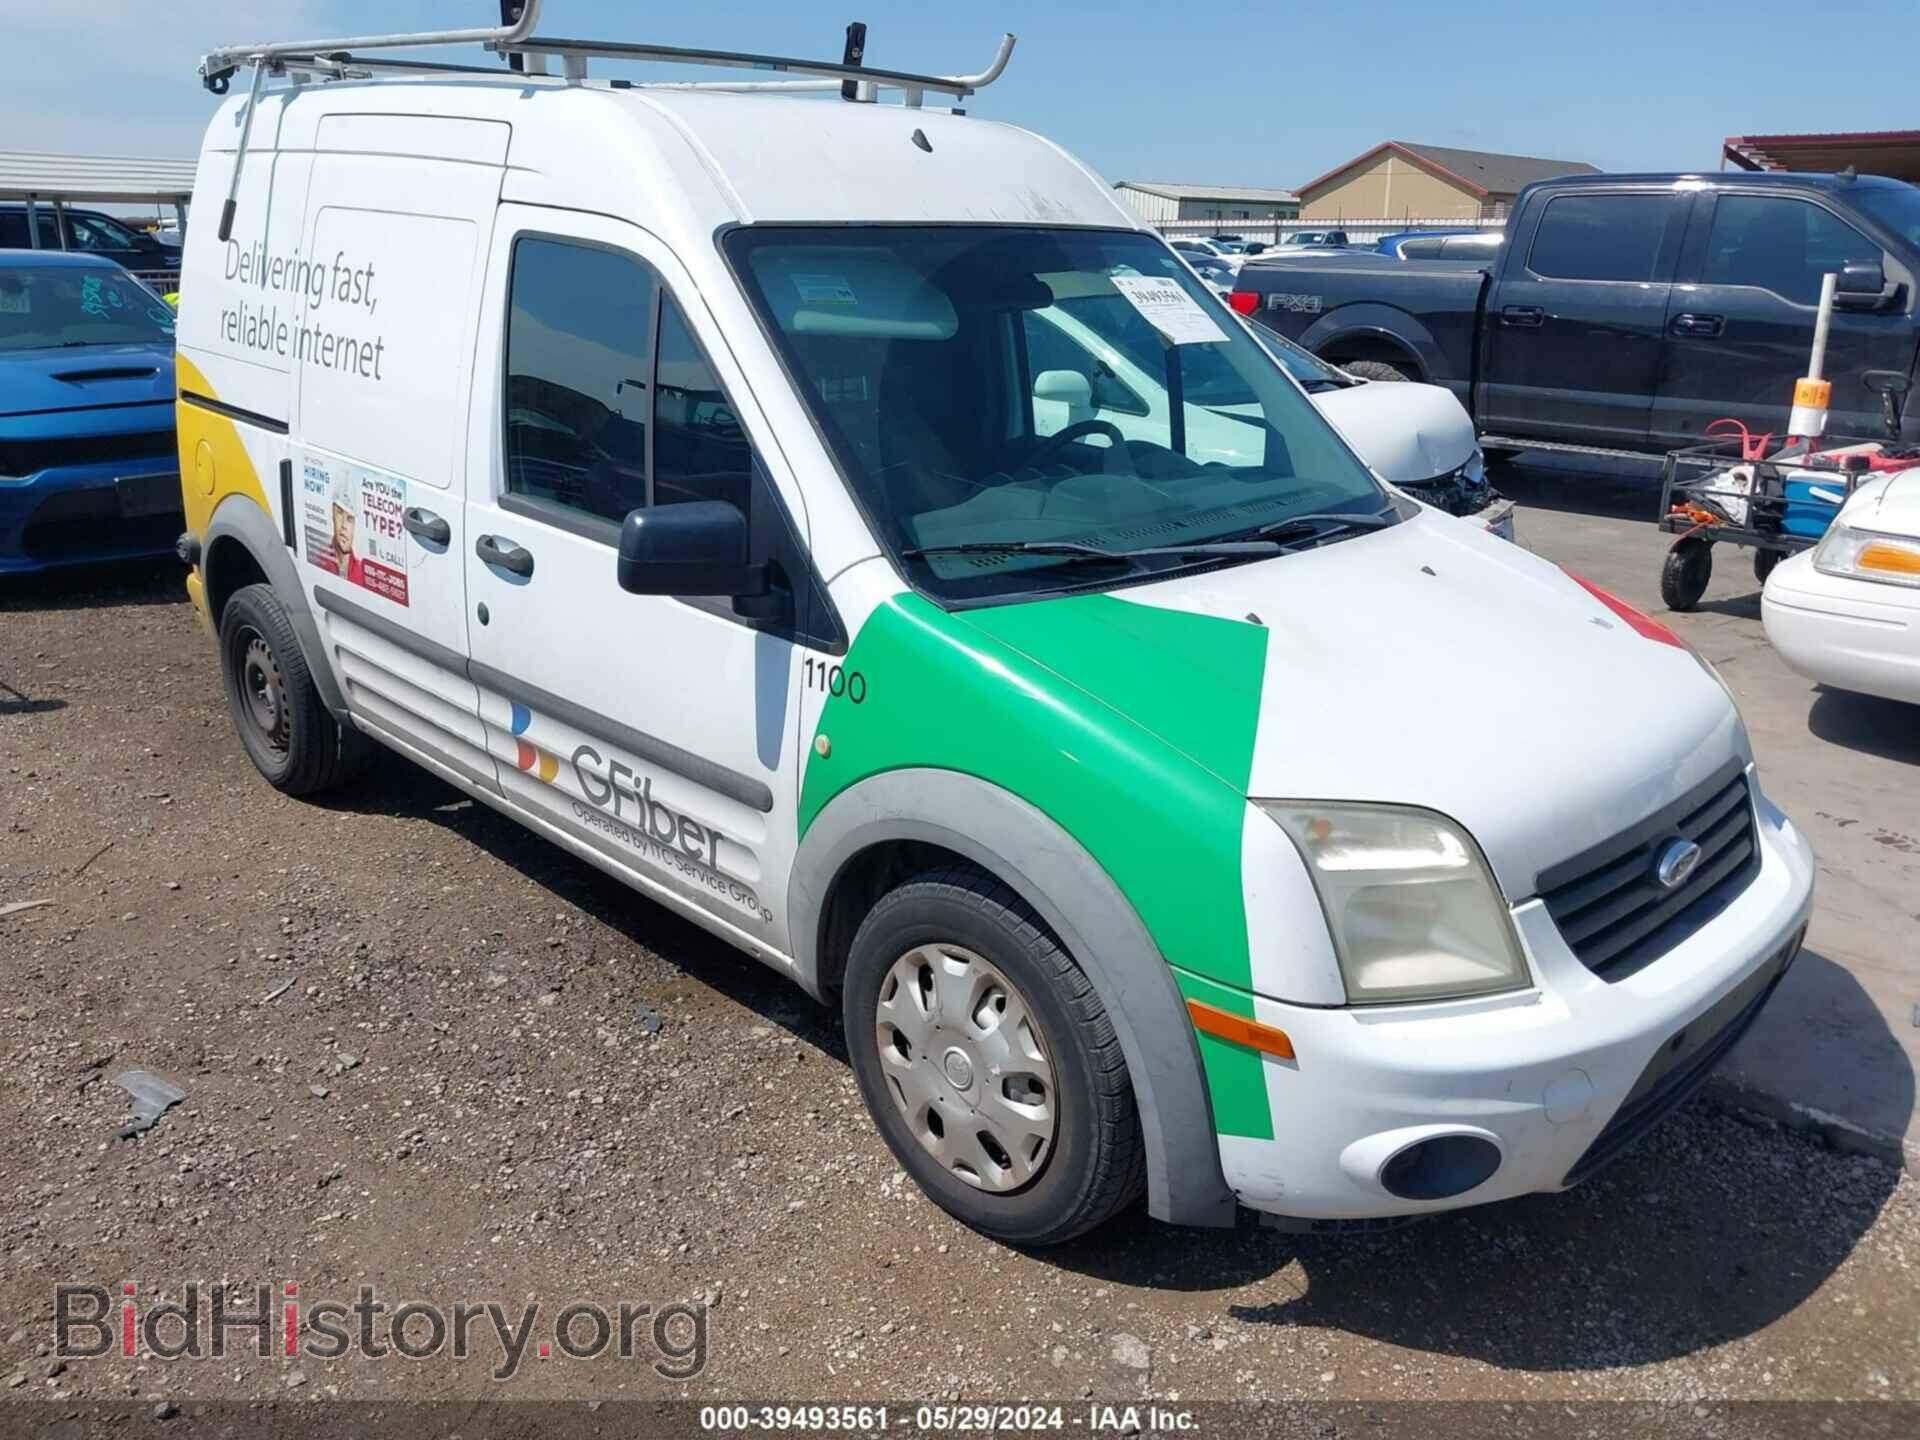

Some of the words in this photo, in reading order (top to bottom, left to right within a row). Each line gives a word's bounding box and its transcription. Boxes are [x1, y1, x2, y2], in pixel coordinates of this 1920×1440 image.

[225, 237, 326, 309] Delivering
[330, 250, 377, 315] fast,
[1267, 293, 1322, 313] FX4
[220, 299, 287, 355] reliable
[292, 314, 384, 380] internet
[304, 465, 330, 484] HIRING
[361, 477, 374, 490] Are
[375, 480, 390, 496] YOU
[361, 492, 402, 516] TELECOM
[363, 511, 403, 540] TYPE?
[805, 658, 866, 704] 1100
[570, 744, 724, 871] GFiber
[572, 802, 630, 843] Operated
[631, 834, 648, 858] by
[674, 851, 727, 895] Service
[728, 880, 773, 923] Group
